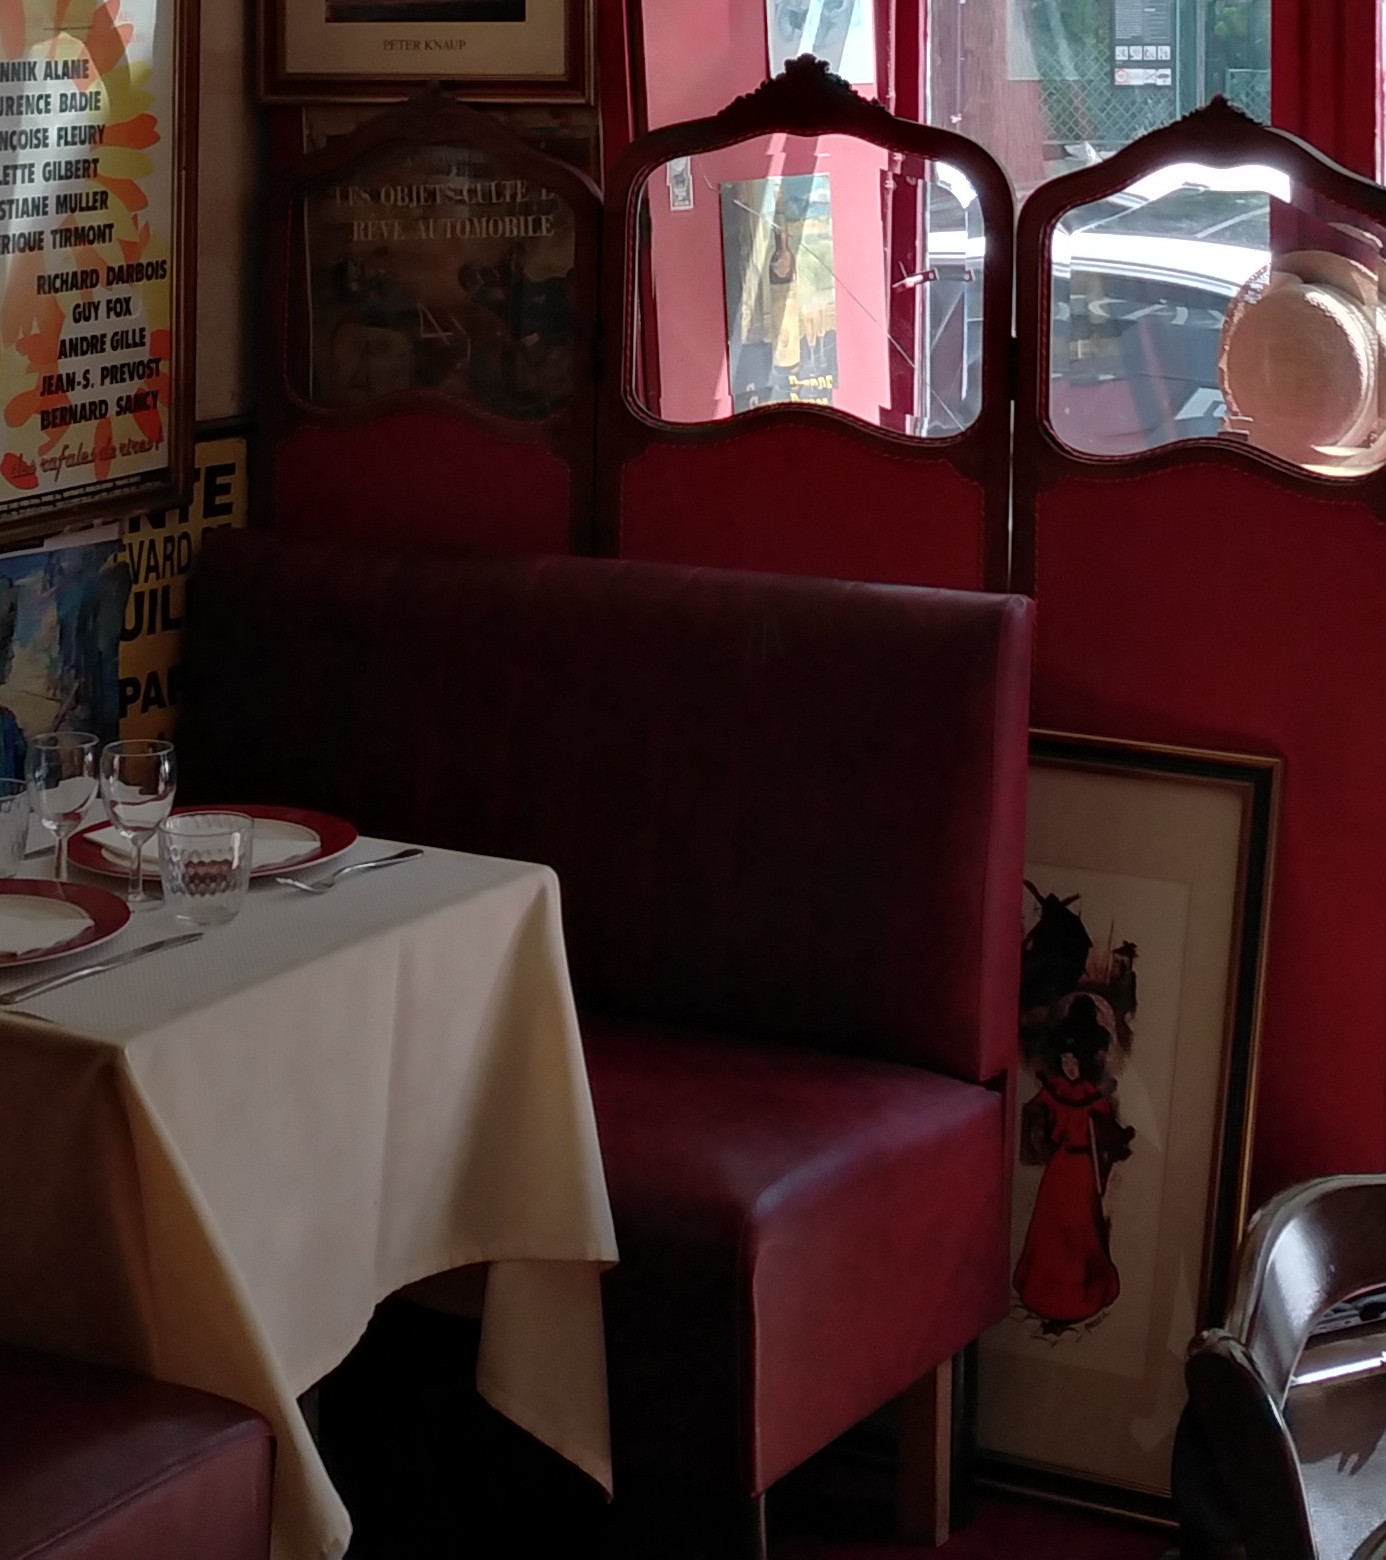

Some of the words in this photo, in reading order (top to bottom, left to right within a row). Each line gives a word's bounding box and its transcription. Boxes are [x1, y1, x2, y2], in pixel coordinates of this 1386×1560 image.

[384, 40, 421, 51] PETER
[425, 40, 466, 51] KNAUP
[44, 59, 89, 80] ALANE
[59, 91, 101, 113] BADIE
[56, 125, 105, 148] FLEURY
[42, 158, 99, 182] GILBERT
[55, 190, 109, 215] MULLER
[51, 224, 114, 249] TIRMONT
[418, 214, 555, 240] AUTOMOBILE
[37, 269, 99, 294] RICHARD
[106, 260, 167, 286] DARBOIS
[72, 301, 100, 324] GUY
[106, 297, 132, 319] FOX
[58, 334, 106, 359] ANDRE
[110, 327, 146, 351] GILLE
[100, 358, 161, 385] PREVOST
[40, 400, 108, 430] BERNARD
[116, 390, 159, 416] SANCY
